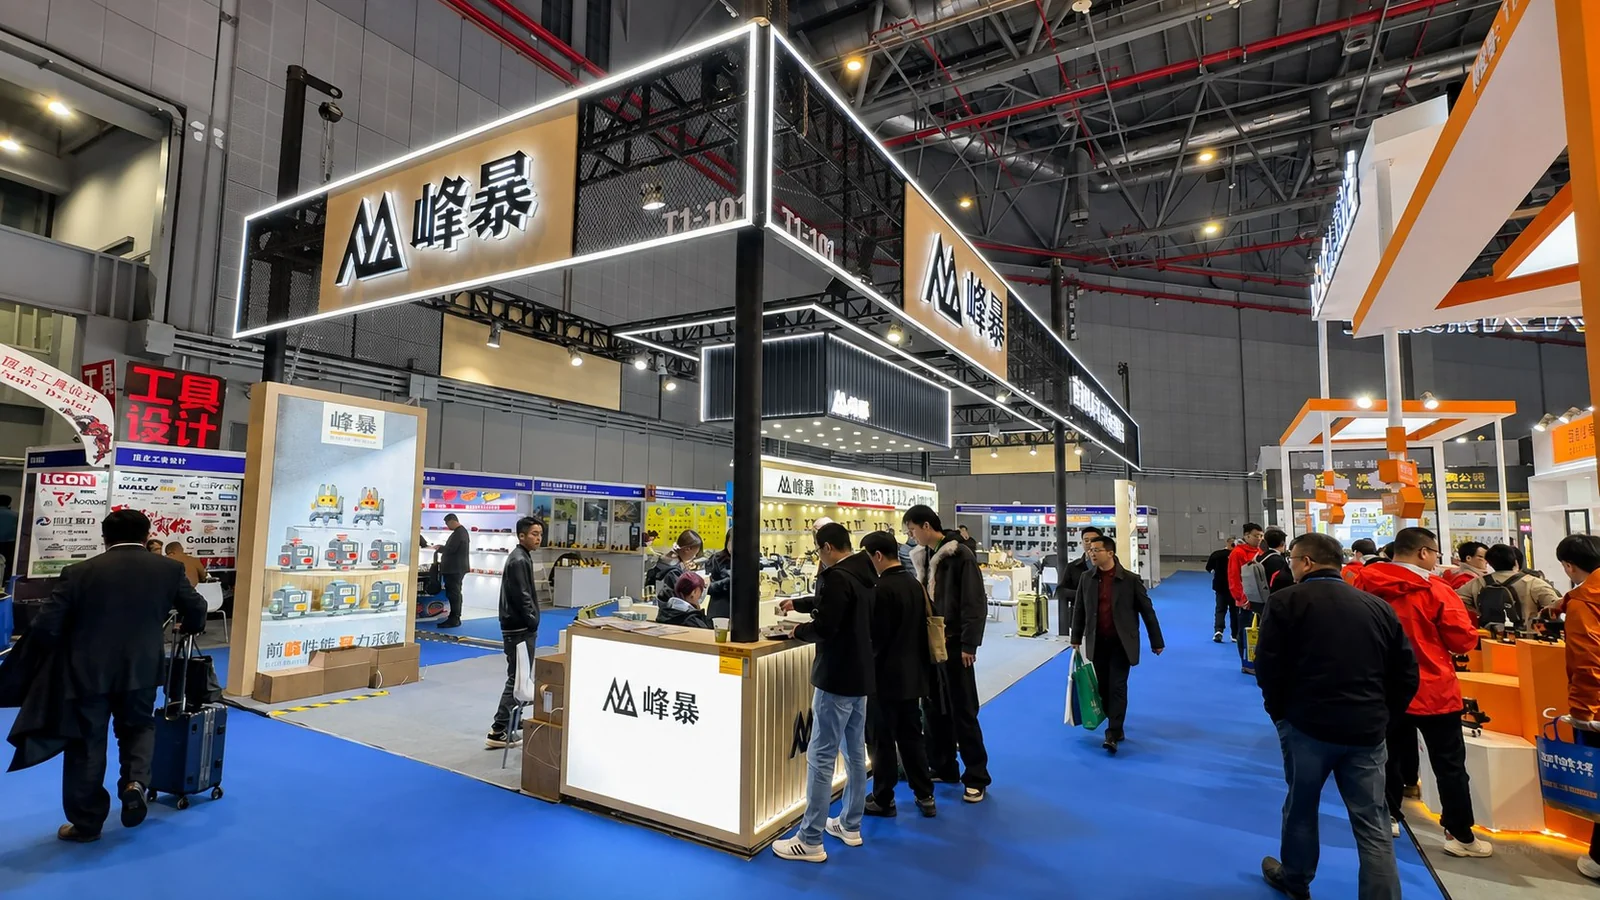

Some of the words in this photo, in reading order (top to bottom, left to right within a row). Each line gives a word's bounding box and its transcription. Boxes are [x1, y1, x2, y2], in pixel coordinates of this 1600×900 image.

[410, 150, 538, 252] 峰暴
[782, 206, 835, 262] T1-101
[961, 271, 1005, 351] 峰暴
[129, 365, 220, 414] 工具
[126, 404, 217, 448] 设计
[330, 410, 377, 435] 峰暴
[43, 473, 92, 485] ICON
[793, 477, 815, 497] 峰暴
[186, 536, 236, 544] Goldblatt
[643, 685, 700, 725] 峰暴
